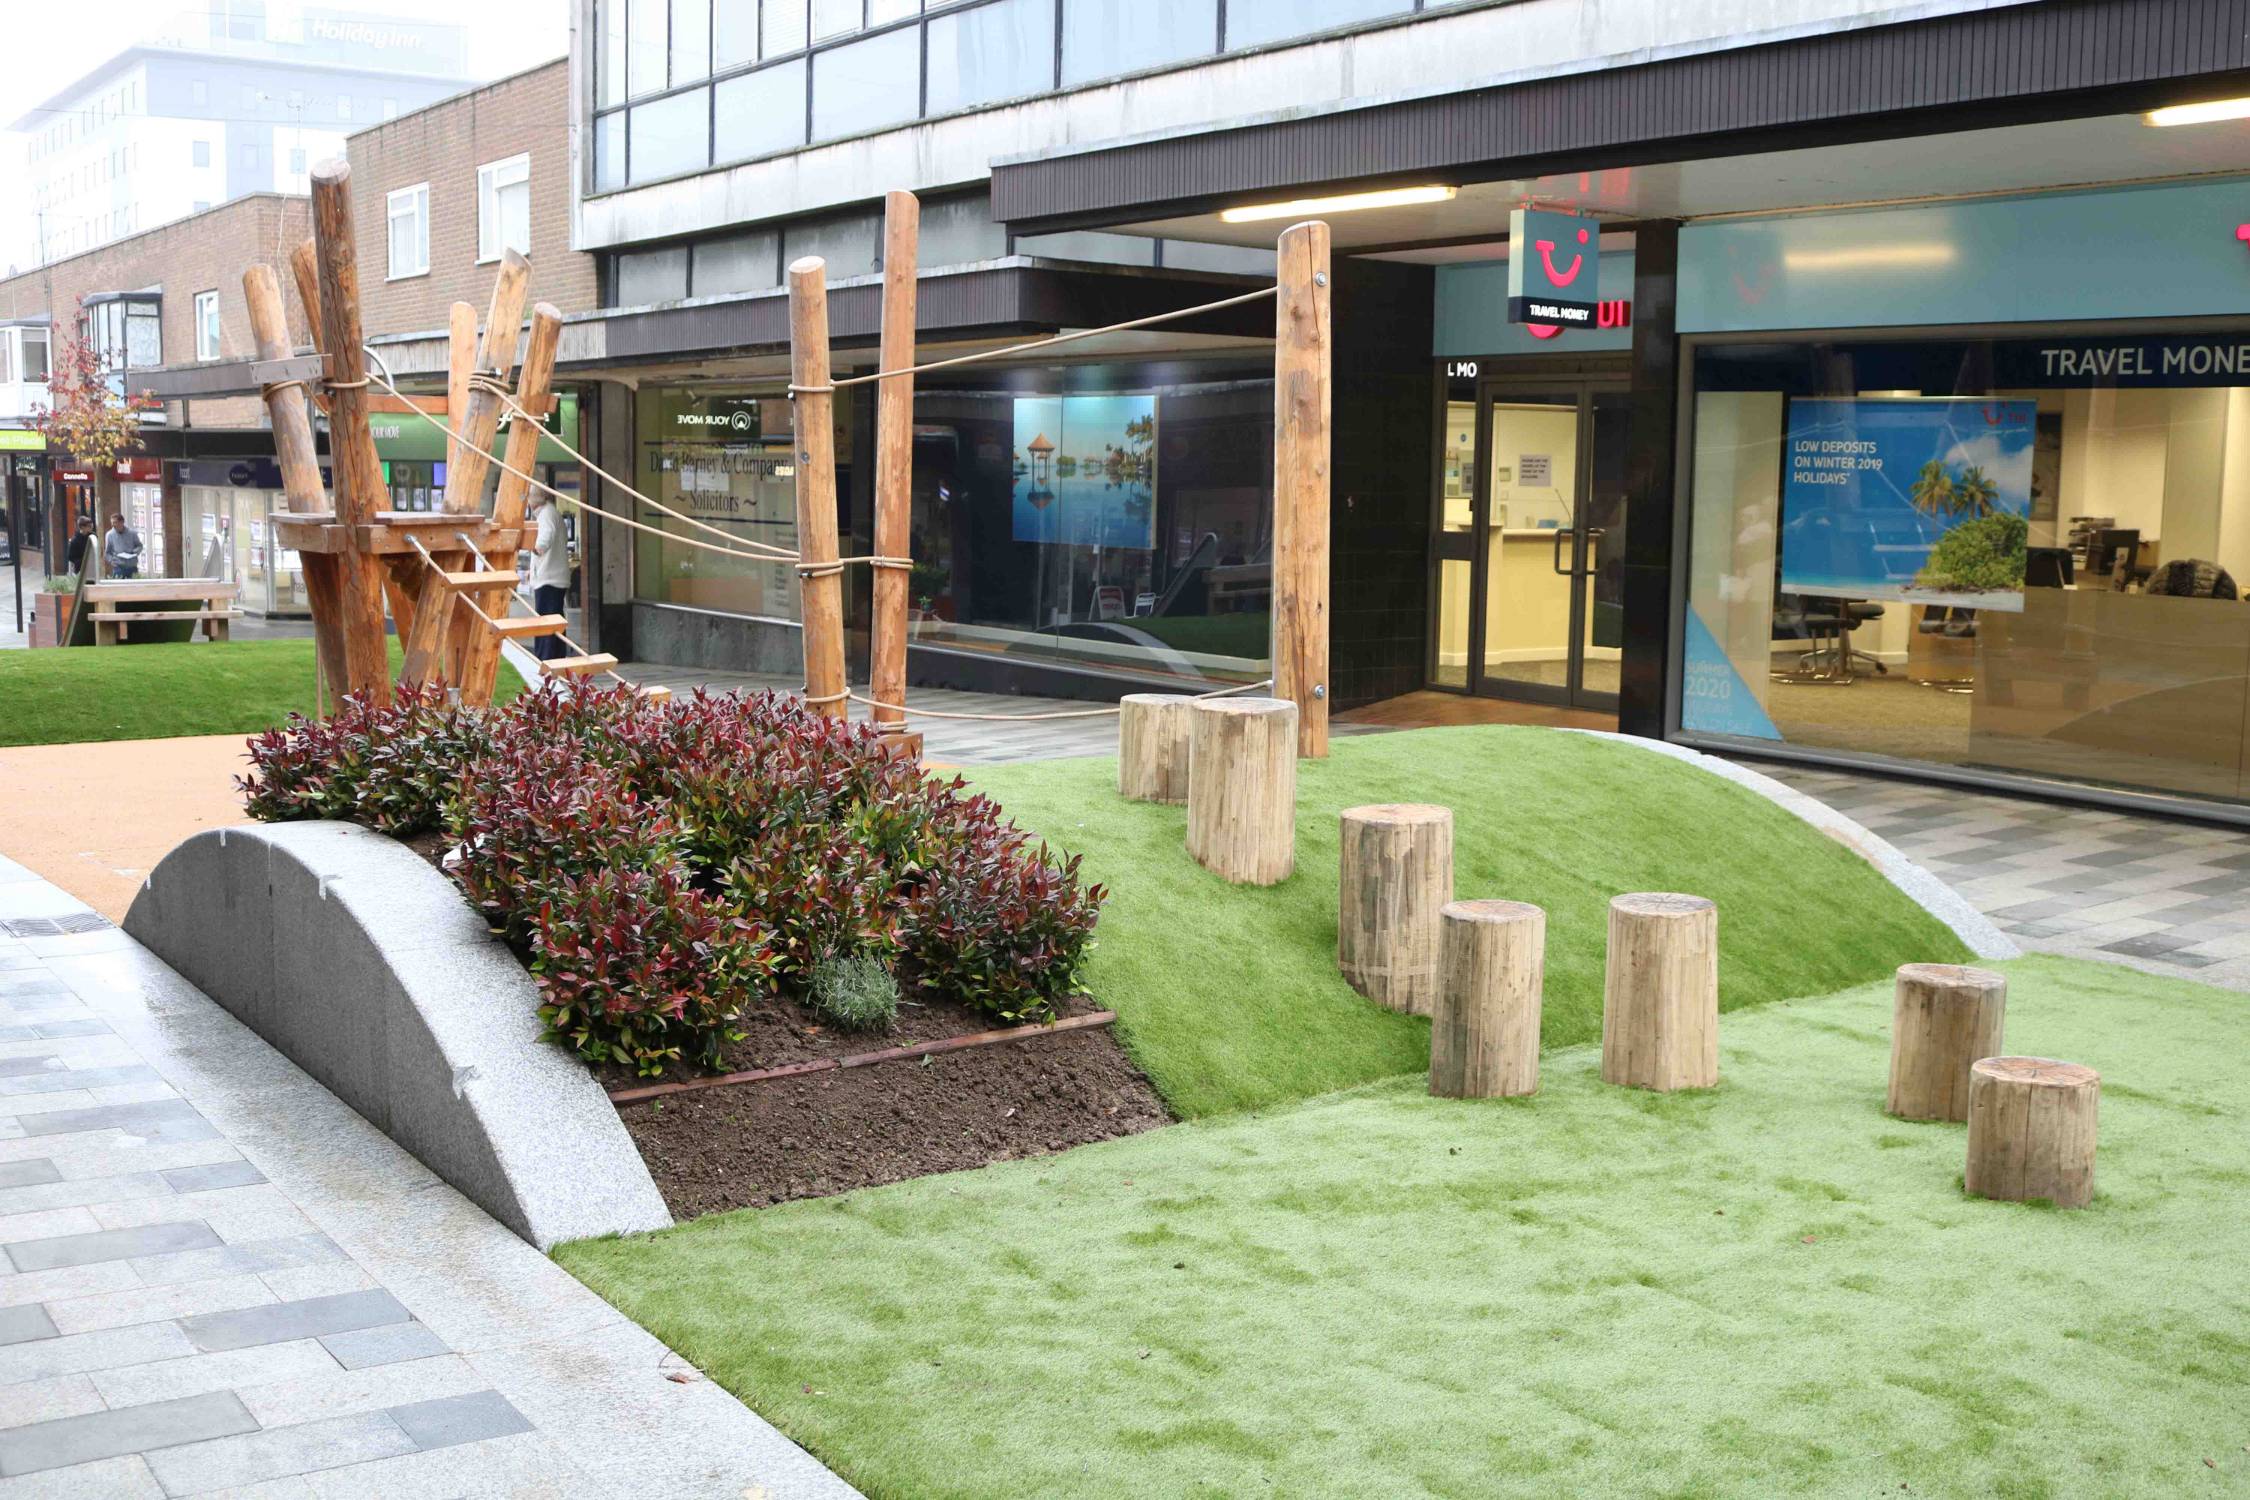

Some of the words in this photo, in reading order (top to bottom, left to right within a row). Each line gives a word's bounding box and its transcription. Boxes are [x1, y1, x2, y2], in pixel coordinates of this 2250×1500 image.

[312, 18, 387, 49] Holiday
[1530, 304, 1560, 318] TRAVEL
[1560, 307, 1589, 321] MONEY
[1597, 300, 1626, 329] UI
[2041, 348, 2153, 376] TRAVEL
[2162, 345, 2250, 375] MONE
[1795, 440, 1820, 453] LOW
[1821, 440, 1877, 455] DEPOSITS
[733, 452, 788, 482] Company
[1794, 455, 1810, 468] ON
[1813, 456, 1856, 470] WINTER
[1858, 458, 1884, 472] 2019
[689, 490, 740, 513] Solicitors
[1686, 675, 1731, 700] 2020
